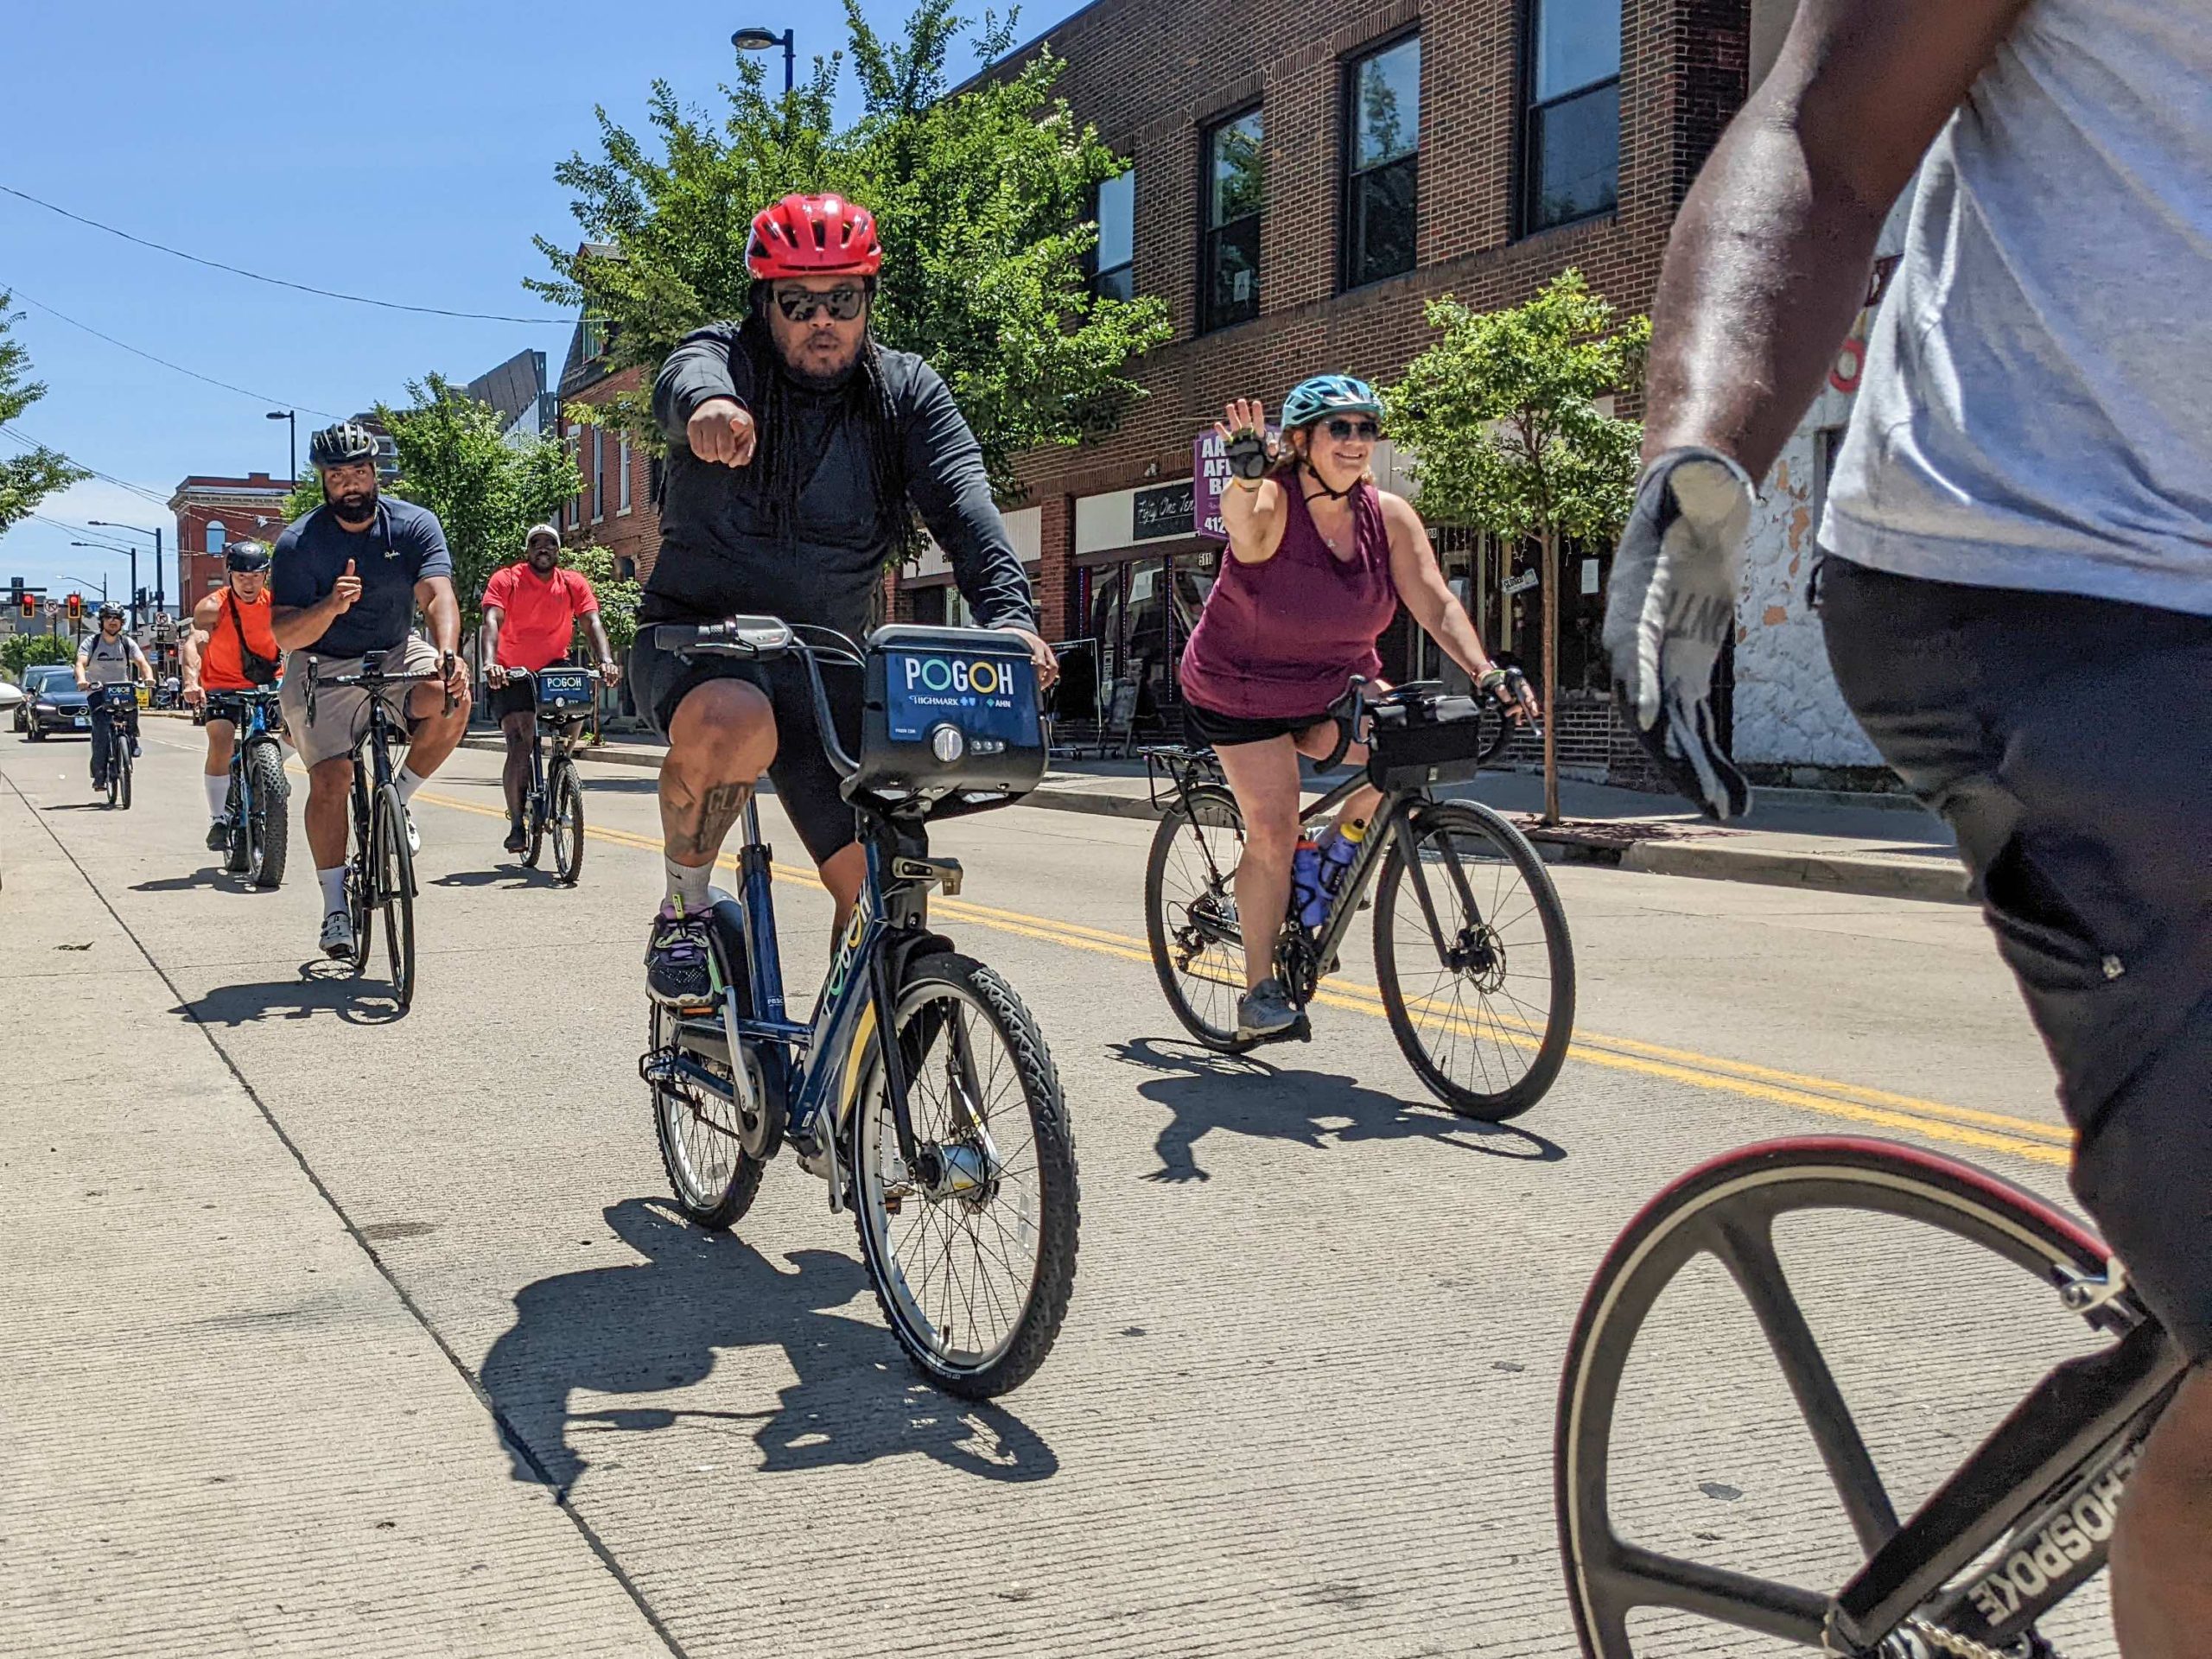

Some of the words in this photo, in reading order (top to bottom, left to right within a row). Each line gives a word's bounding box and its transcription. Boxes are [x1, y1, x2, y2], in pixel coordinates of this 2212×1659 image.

[547, 677, 582, 688] POGOH
[905, 658, 1014, 696] POGOH
[911, 696, 959, 706] HIGHMARK
[995, 699, 1012, 708] AHN
[1968, 1442, 2146, 1627] HOSPOKE
